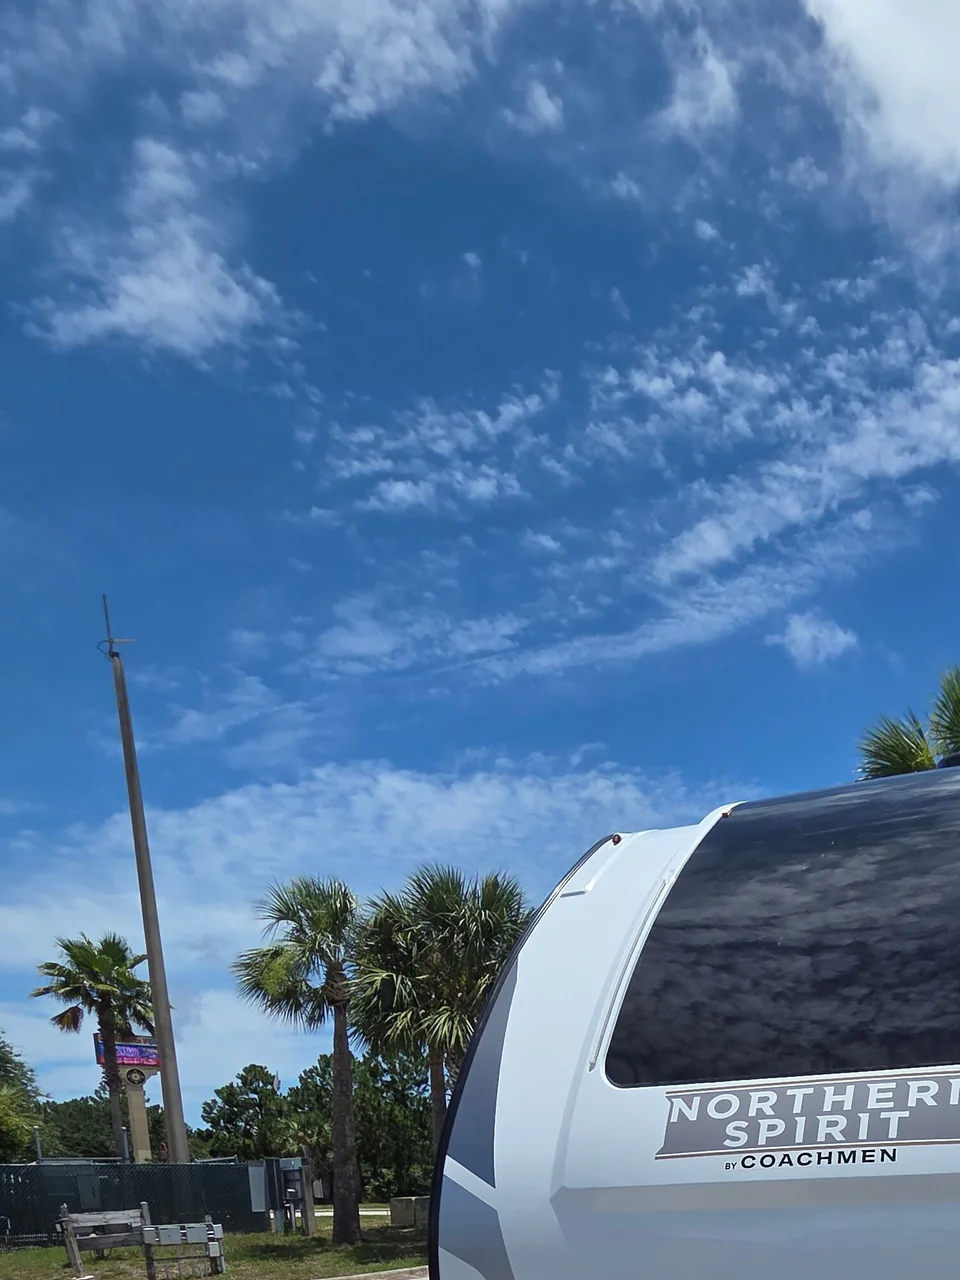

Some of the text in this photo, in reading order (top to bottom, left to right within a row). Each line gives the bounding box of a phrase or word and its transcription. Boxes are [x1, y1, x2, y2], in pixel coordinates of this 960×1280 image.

[723, 1110, 910, 1148] SPIRIT
[725, 1149, 897, 1171] BY COACHMEN
